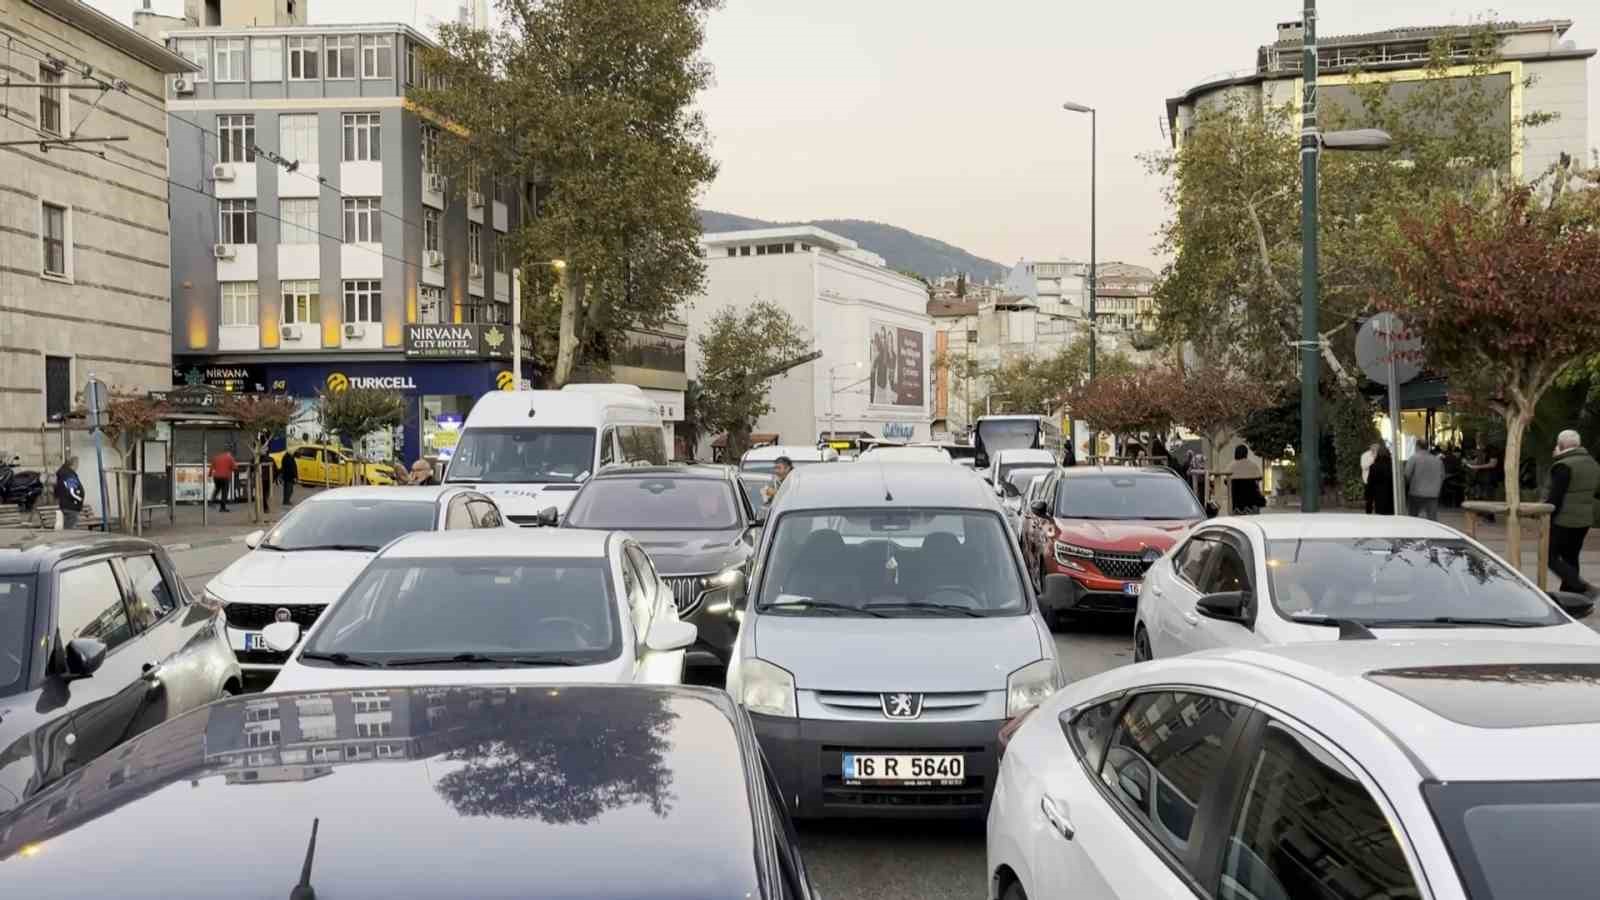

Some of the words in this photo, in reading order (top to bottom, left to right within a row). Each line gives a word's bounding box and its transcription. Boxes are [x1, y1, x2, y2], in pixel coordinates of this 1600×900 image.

[411, 326, 472, 340] NİRVANA
[414, 340, 435, 349] CITY
[437, 340, 469, 349] HOTEL
[206, 367, 249, 379] NİRVANA
[349, 376, 417, 389] TURKCELL
[855, 758, 875, 776] 16
[884, 758, 898, 776] R
[911, 758, 961, 776] 5640
